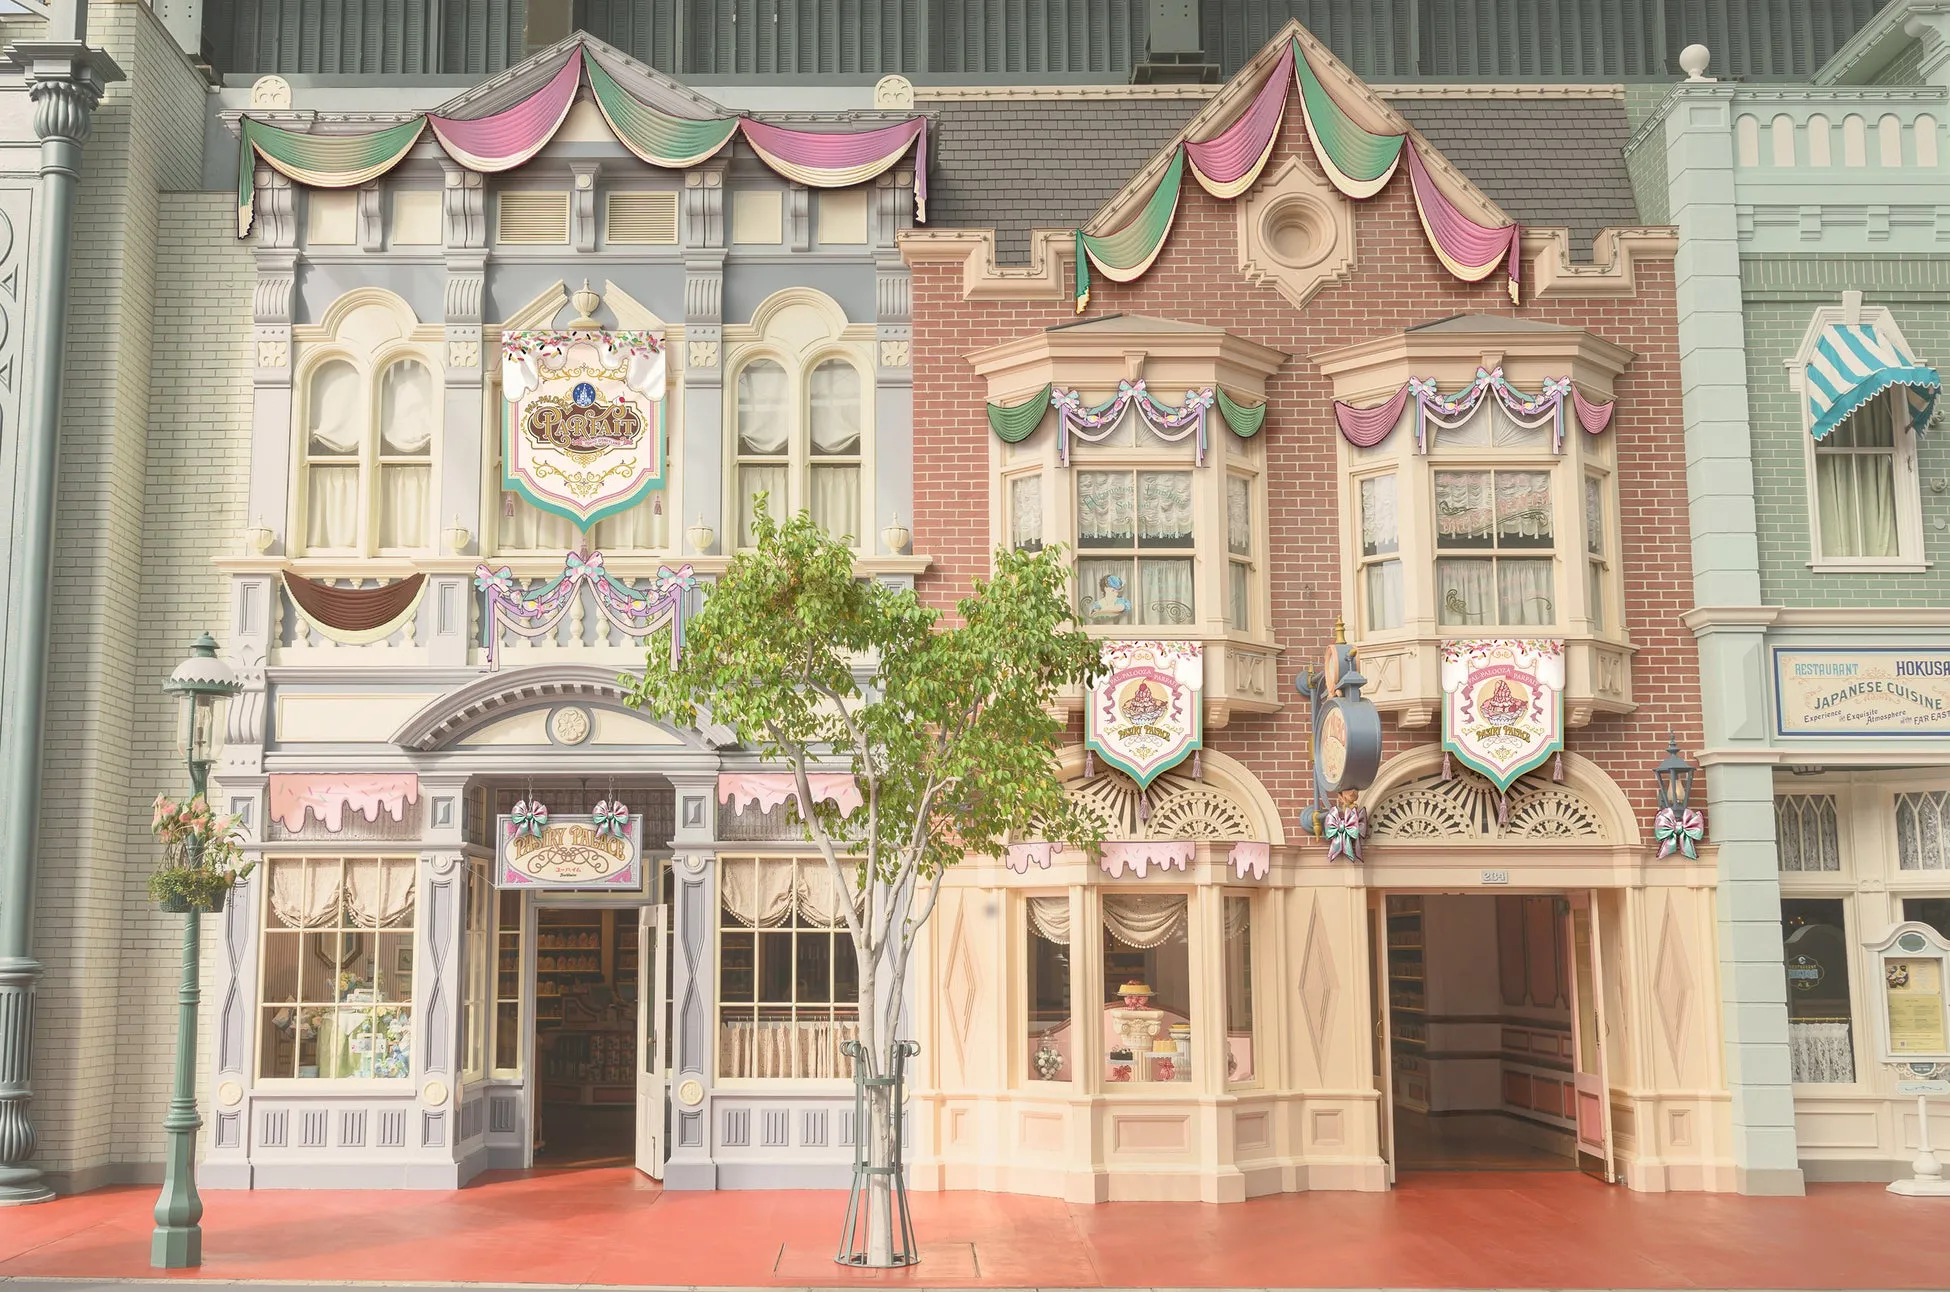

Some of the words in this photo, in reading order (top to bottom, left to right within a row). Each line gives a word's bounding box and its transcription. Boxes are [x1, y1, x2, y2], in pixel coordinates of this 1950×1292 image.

[533, 404, 636, 447] PARFAIT
[1795, 663, 1859, 676] RESTAURANT
[1896, 660, 1950, 677] HOKUSA
[1814, 681, 1883, 710] JAPANESE
[1887, 682, 1943, 710] CUISINE
[1804, 709, 1842, 723] Experience
[1846, 709, 1878, 721] Exquisite
[1866, 710, 1907, 725] Atmosphere
[1913, 714, 1930, 725] FAR
[513, 826, 567, 861] PASTRY
[569, 825, 625, 861] PALACE
